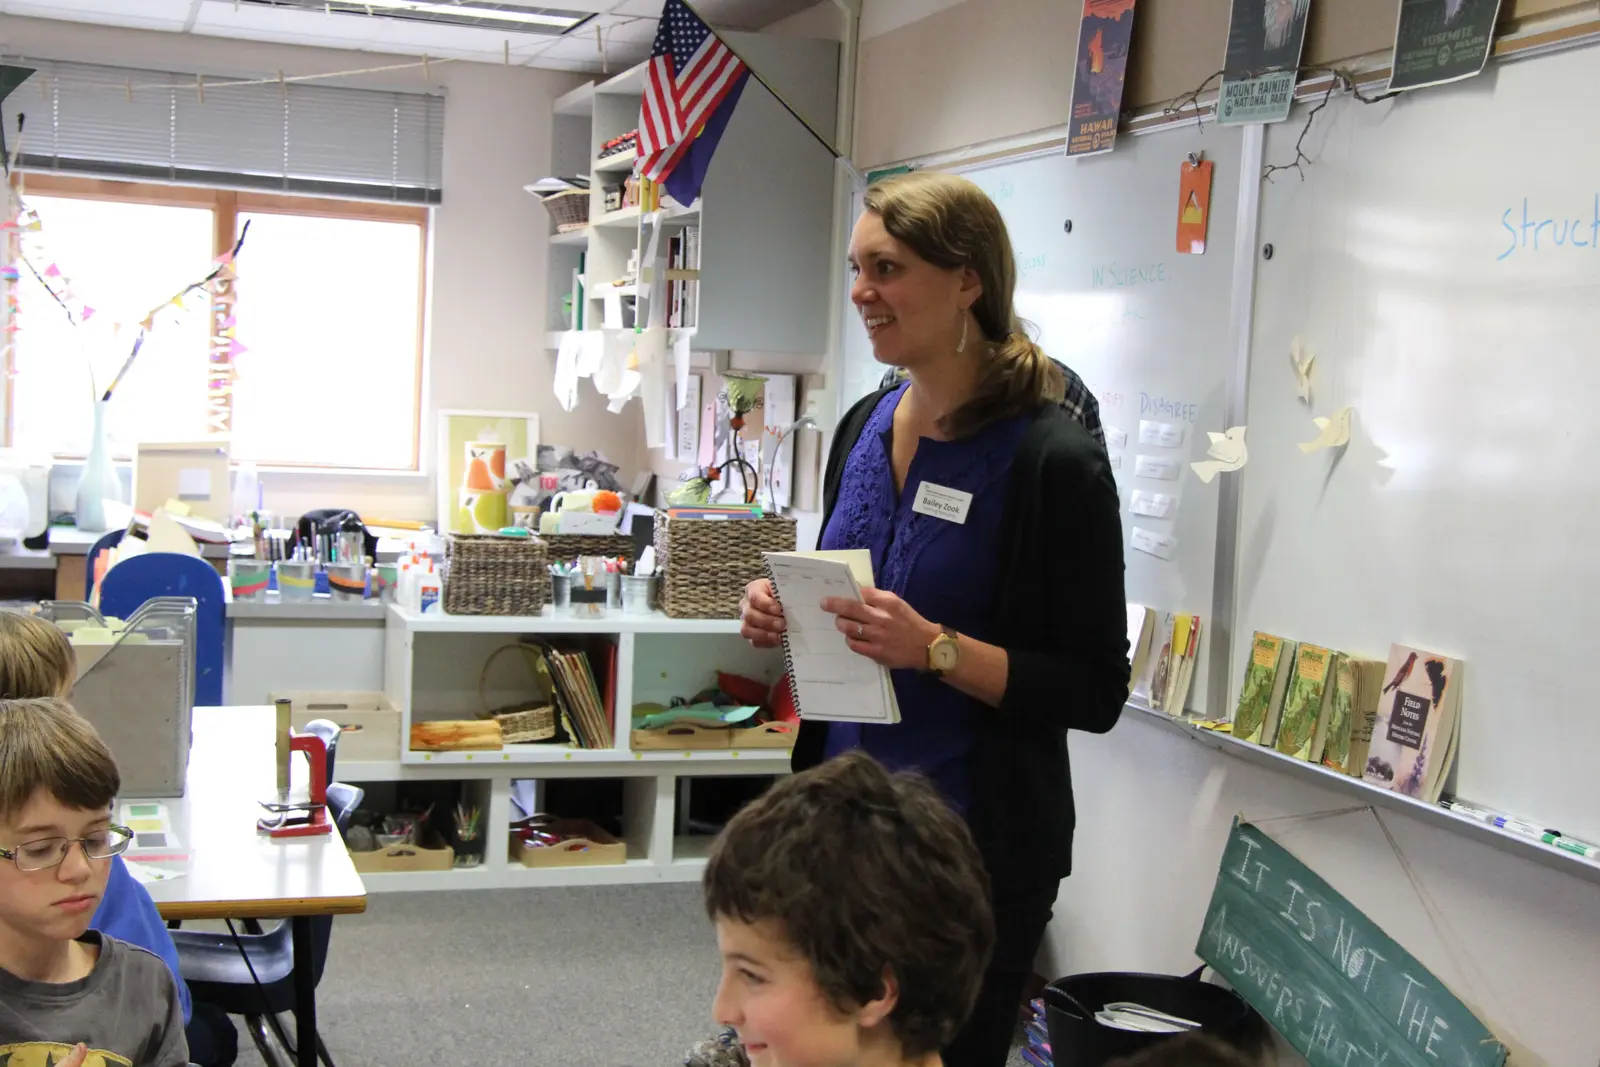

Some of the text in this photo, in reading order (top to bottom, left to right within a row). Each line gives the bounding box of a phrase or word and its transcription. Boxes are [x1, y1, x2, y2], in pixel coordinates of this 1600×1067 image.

[1422, 25, 1475, 47] YOSEMITE
[1226, 79, 1290, 98] MOUNT RAINIER
[1234, 92, 1287, 108] NATIONAL PARK
[1080, 118, 1113, 135] HAWAII
[1092, 269, 1104, 289] IN
[1139, 391, 1199, 424] DISAGREE
[922, 497, 943, 510] Bailey
[943, 503, 960, 514] Zook
[1231, 834, 1449, 1059] IT IS NOT THE
[1207, 903, 1305, 1032] ANSWERS
